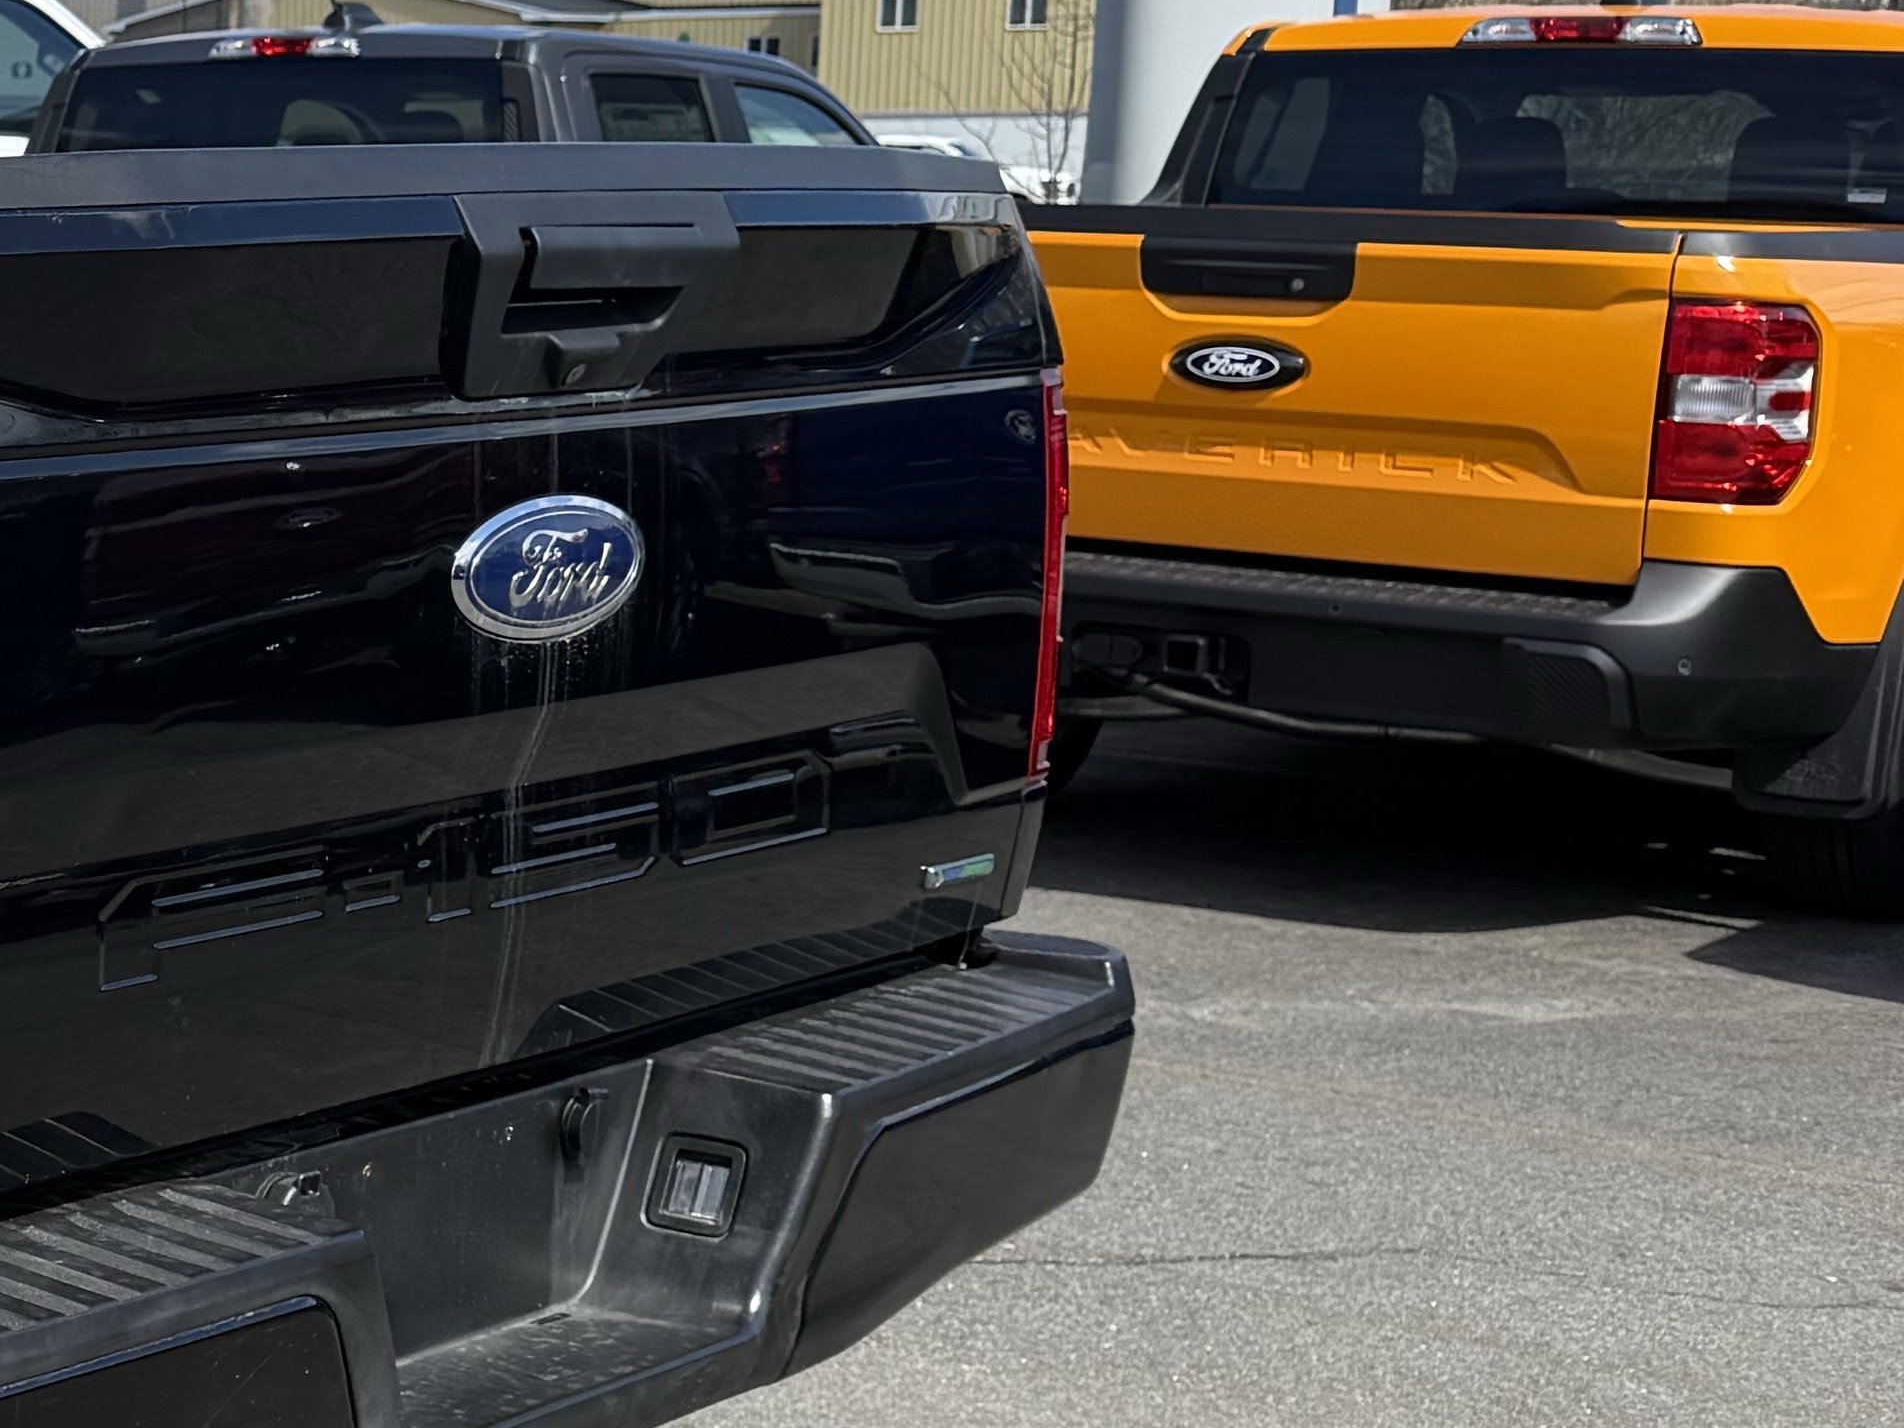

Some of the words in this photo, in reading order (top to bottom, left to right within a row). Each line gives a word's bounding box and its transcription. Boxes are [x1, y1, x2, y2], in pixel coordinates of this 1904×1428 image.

[1202, 349, 1263, 377] Ford
[1068, 427, 1518, 484] AVERICK
[508, 527, 614, 609] Ford
